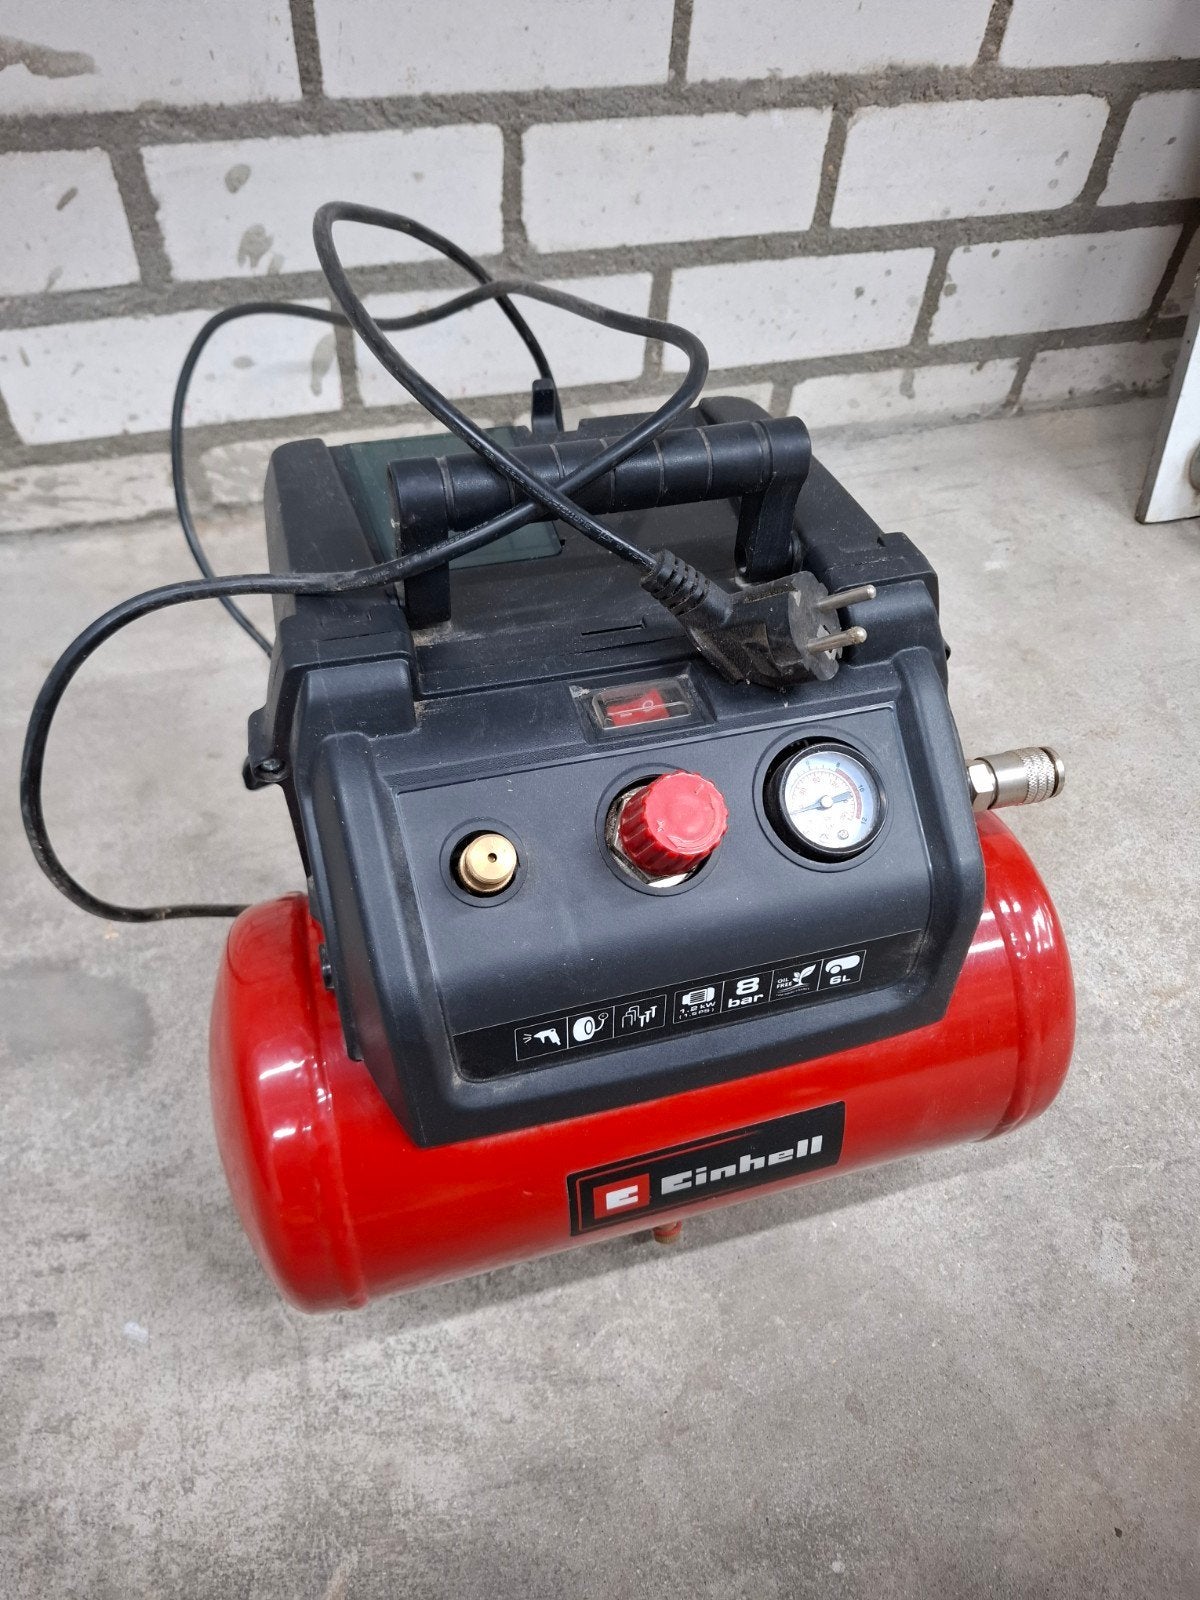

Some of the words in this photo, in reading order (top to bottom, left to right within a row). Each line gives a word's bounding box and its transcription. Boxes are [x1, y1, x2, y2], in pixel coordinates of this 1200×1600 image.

[735, 977, 760, 995] 8
[776, 981, 793, 989] FREE
[829, 975, 852, 985] 6L
[679, 1005, 698, 1014] 1.2
[699, 1001, 716, 1009] kW
[727, 992, 764, 1009] bar
[660, 1134, 824, 1196] Einhell
